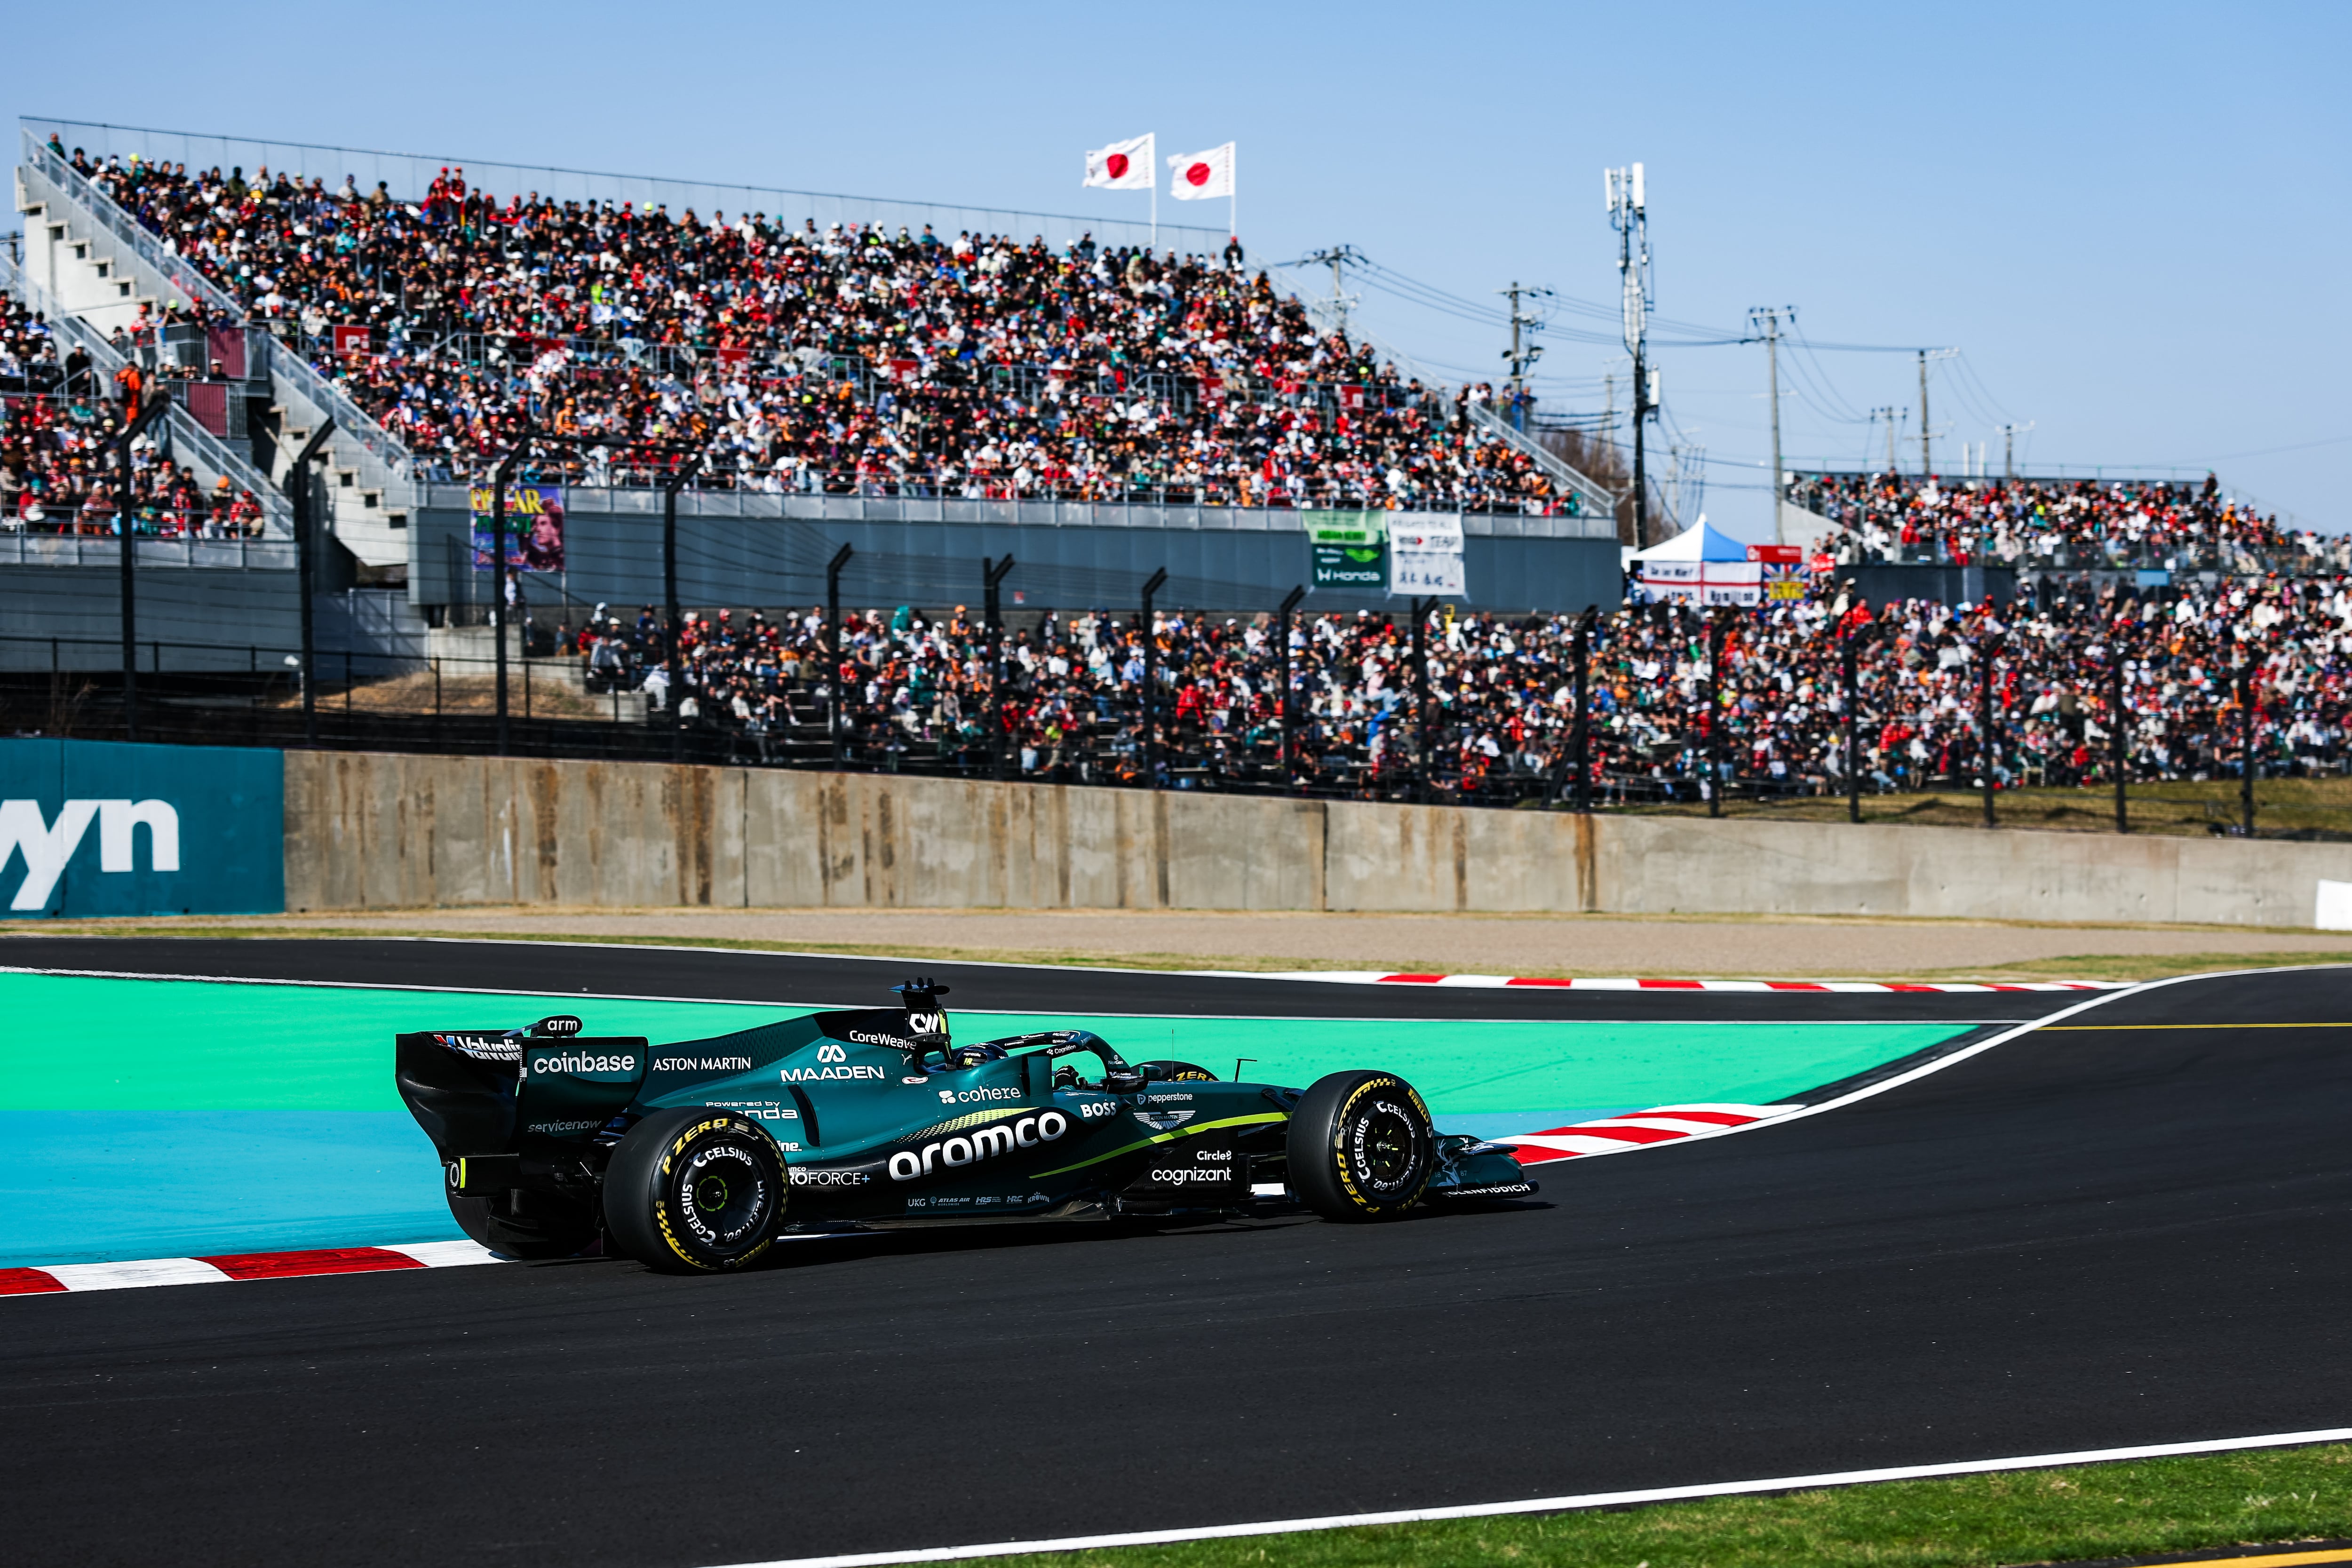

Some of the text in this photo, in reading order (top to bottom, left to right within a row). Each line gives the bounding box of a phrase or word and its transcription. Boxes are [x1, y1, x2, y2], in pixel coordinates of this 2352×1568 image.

[1333, 571, 1381, 581] Honda
[548, 1020, 578, 1031] arm
[849, 1030, 917, 1050] CoreWeave
[1055, 1044, 1076, 1054] Cognition
[534, 1051, 635, 1074] coinbase
[652, 1057, 751, 1071] ASTON MARTIN
[780, 1066, 885, 1082] MAADEN
[958, 1085, 1021, 1103] cohere
[1148, 1092, 1193, 1104] pepperstone
[1080, 1101, 1117, 1118] BOSS
[527, 1119, 602, 1132] servicenow
[1387, 1103, 1415, 1138] CELSIUS
[662, 1118, 729, 1175] P ZERO
[889, 1111, 1067, 1182] aramco
[1354, 1117, 1369, 1168] CELSIUS
[705, 1147, 753, 1166] CELSIUS
[1152, 1166, 1232, 1186] cognizant
[1336, 1152, 1367, 1206] ZERO
[1447, 1184, 1531, 1195] GLENFIDDICH
[908, 1198, 926, 1207] UKG
[1028, 1194, 1049, 1203] KROWN
[682, 1183, 706, 1235] CELSIUS
